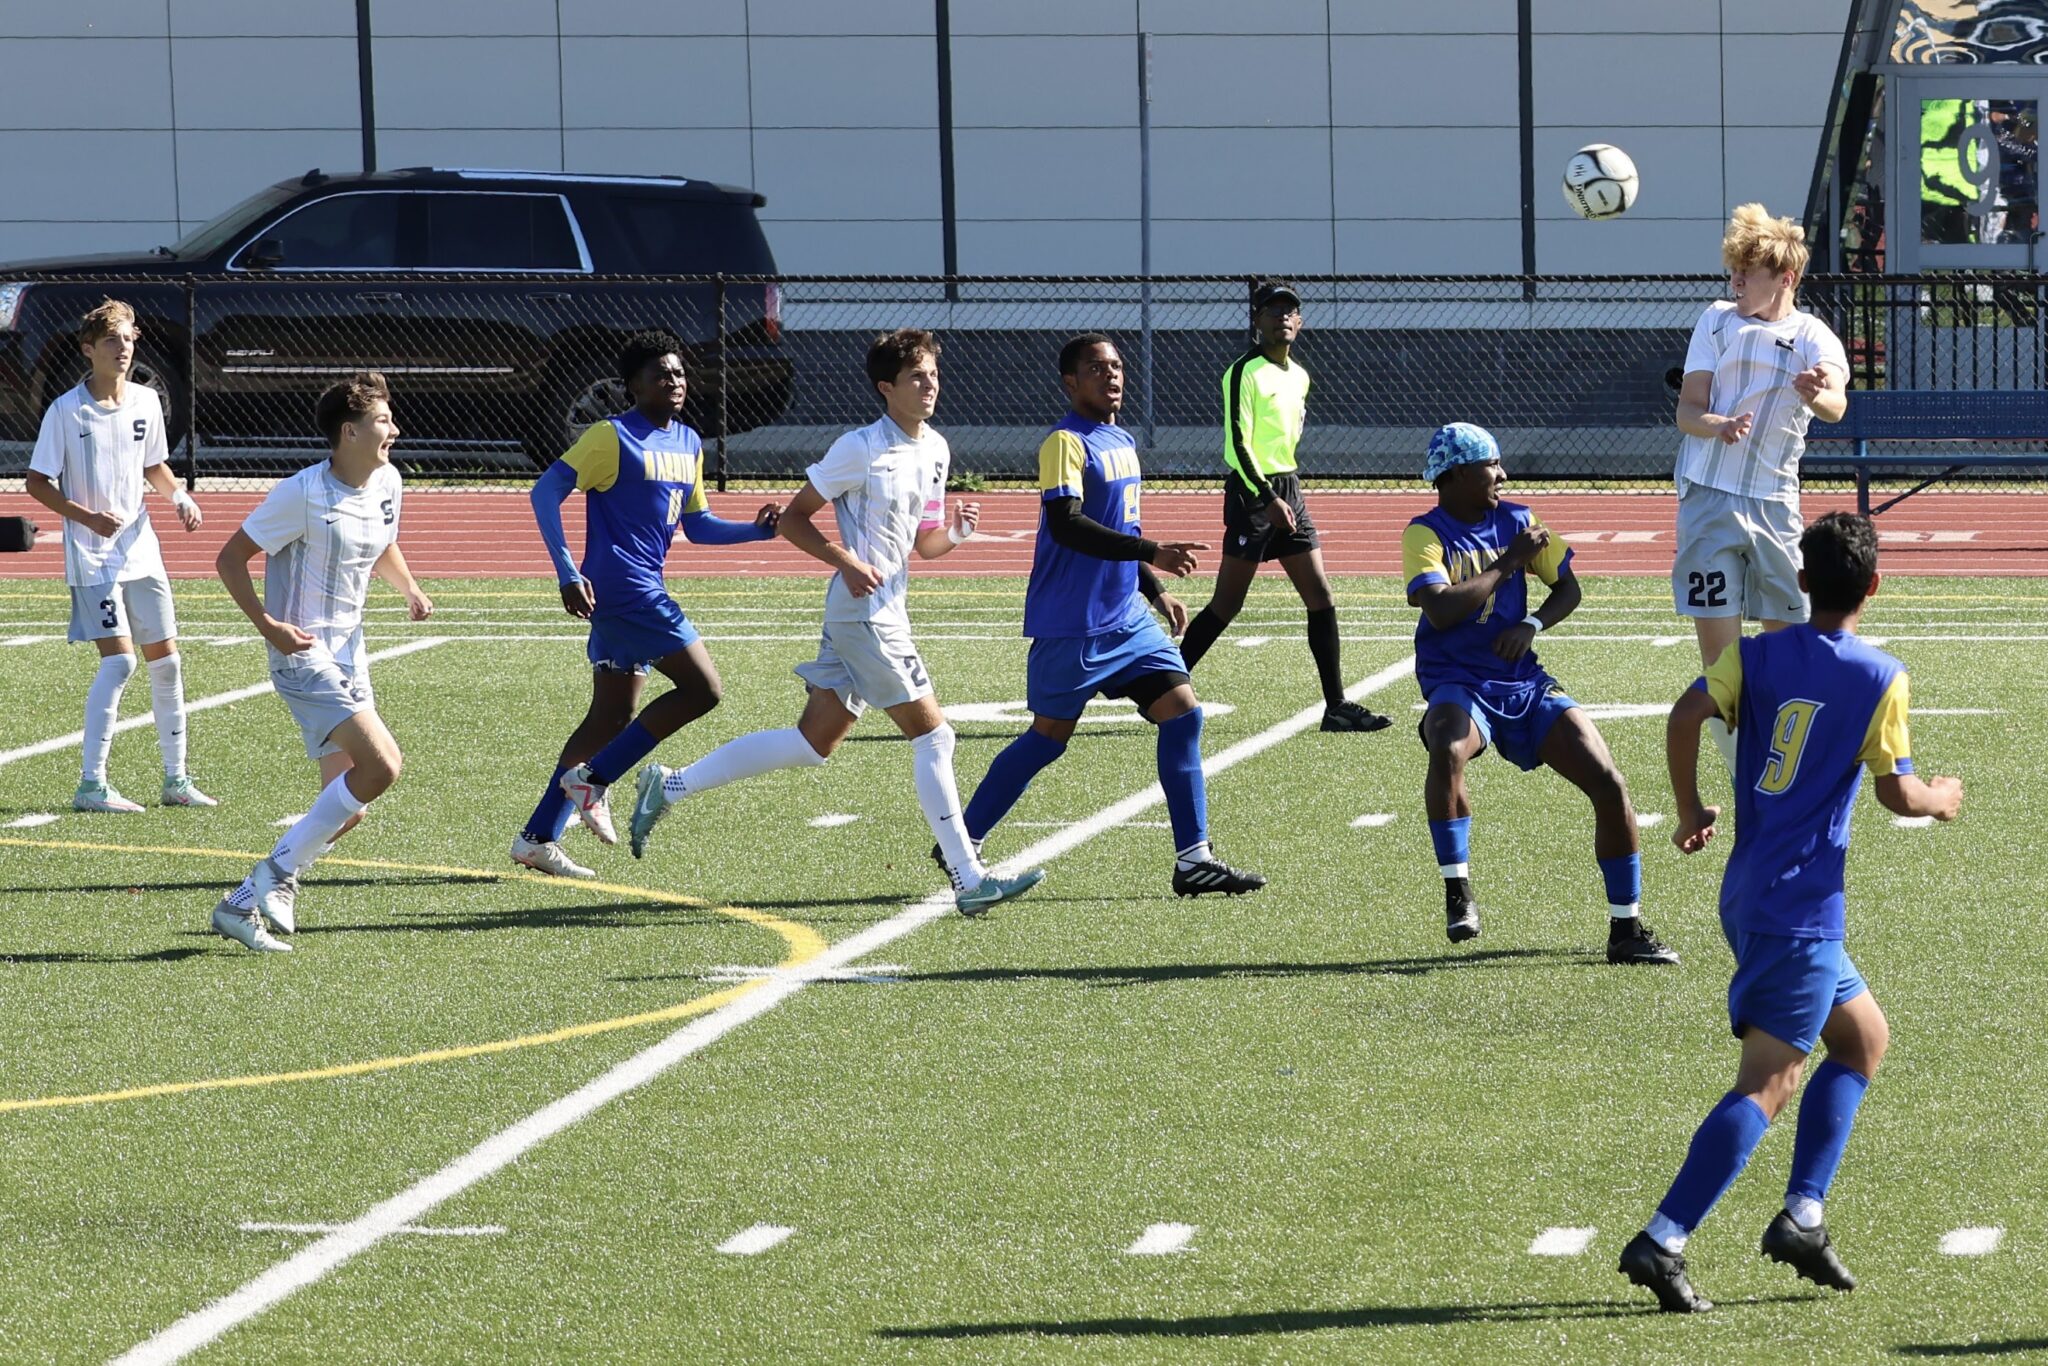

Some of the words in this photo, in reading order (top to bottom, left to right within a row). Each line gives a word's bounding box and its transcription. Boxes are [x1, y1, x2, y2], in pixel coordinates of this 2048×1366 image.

[133, 419, 147, 441] S
[380, 499, 395, 525] S
[1687, 570, 1728, 607] 22
[100, 599, 119, 629] 3
[903, 655, 928, 688] 2
[1754, 697, 1826, 796] 9
